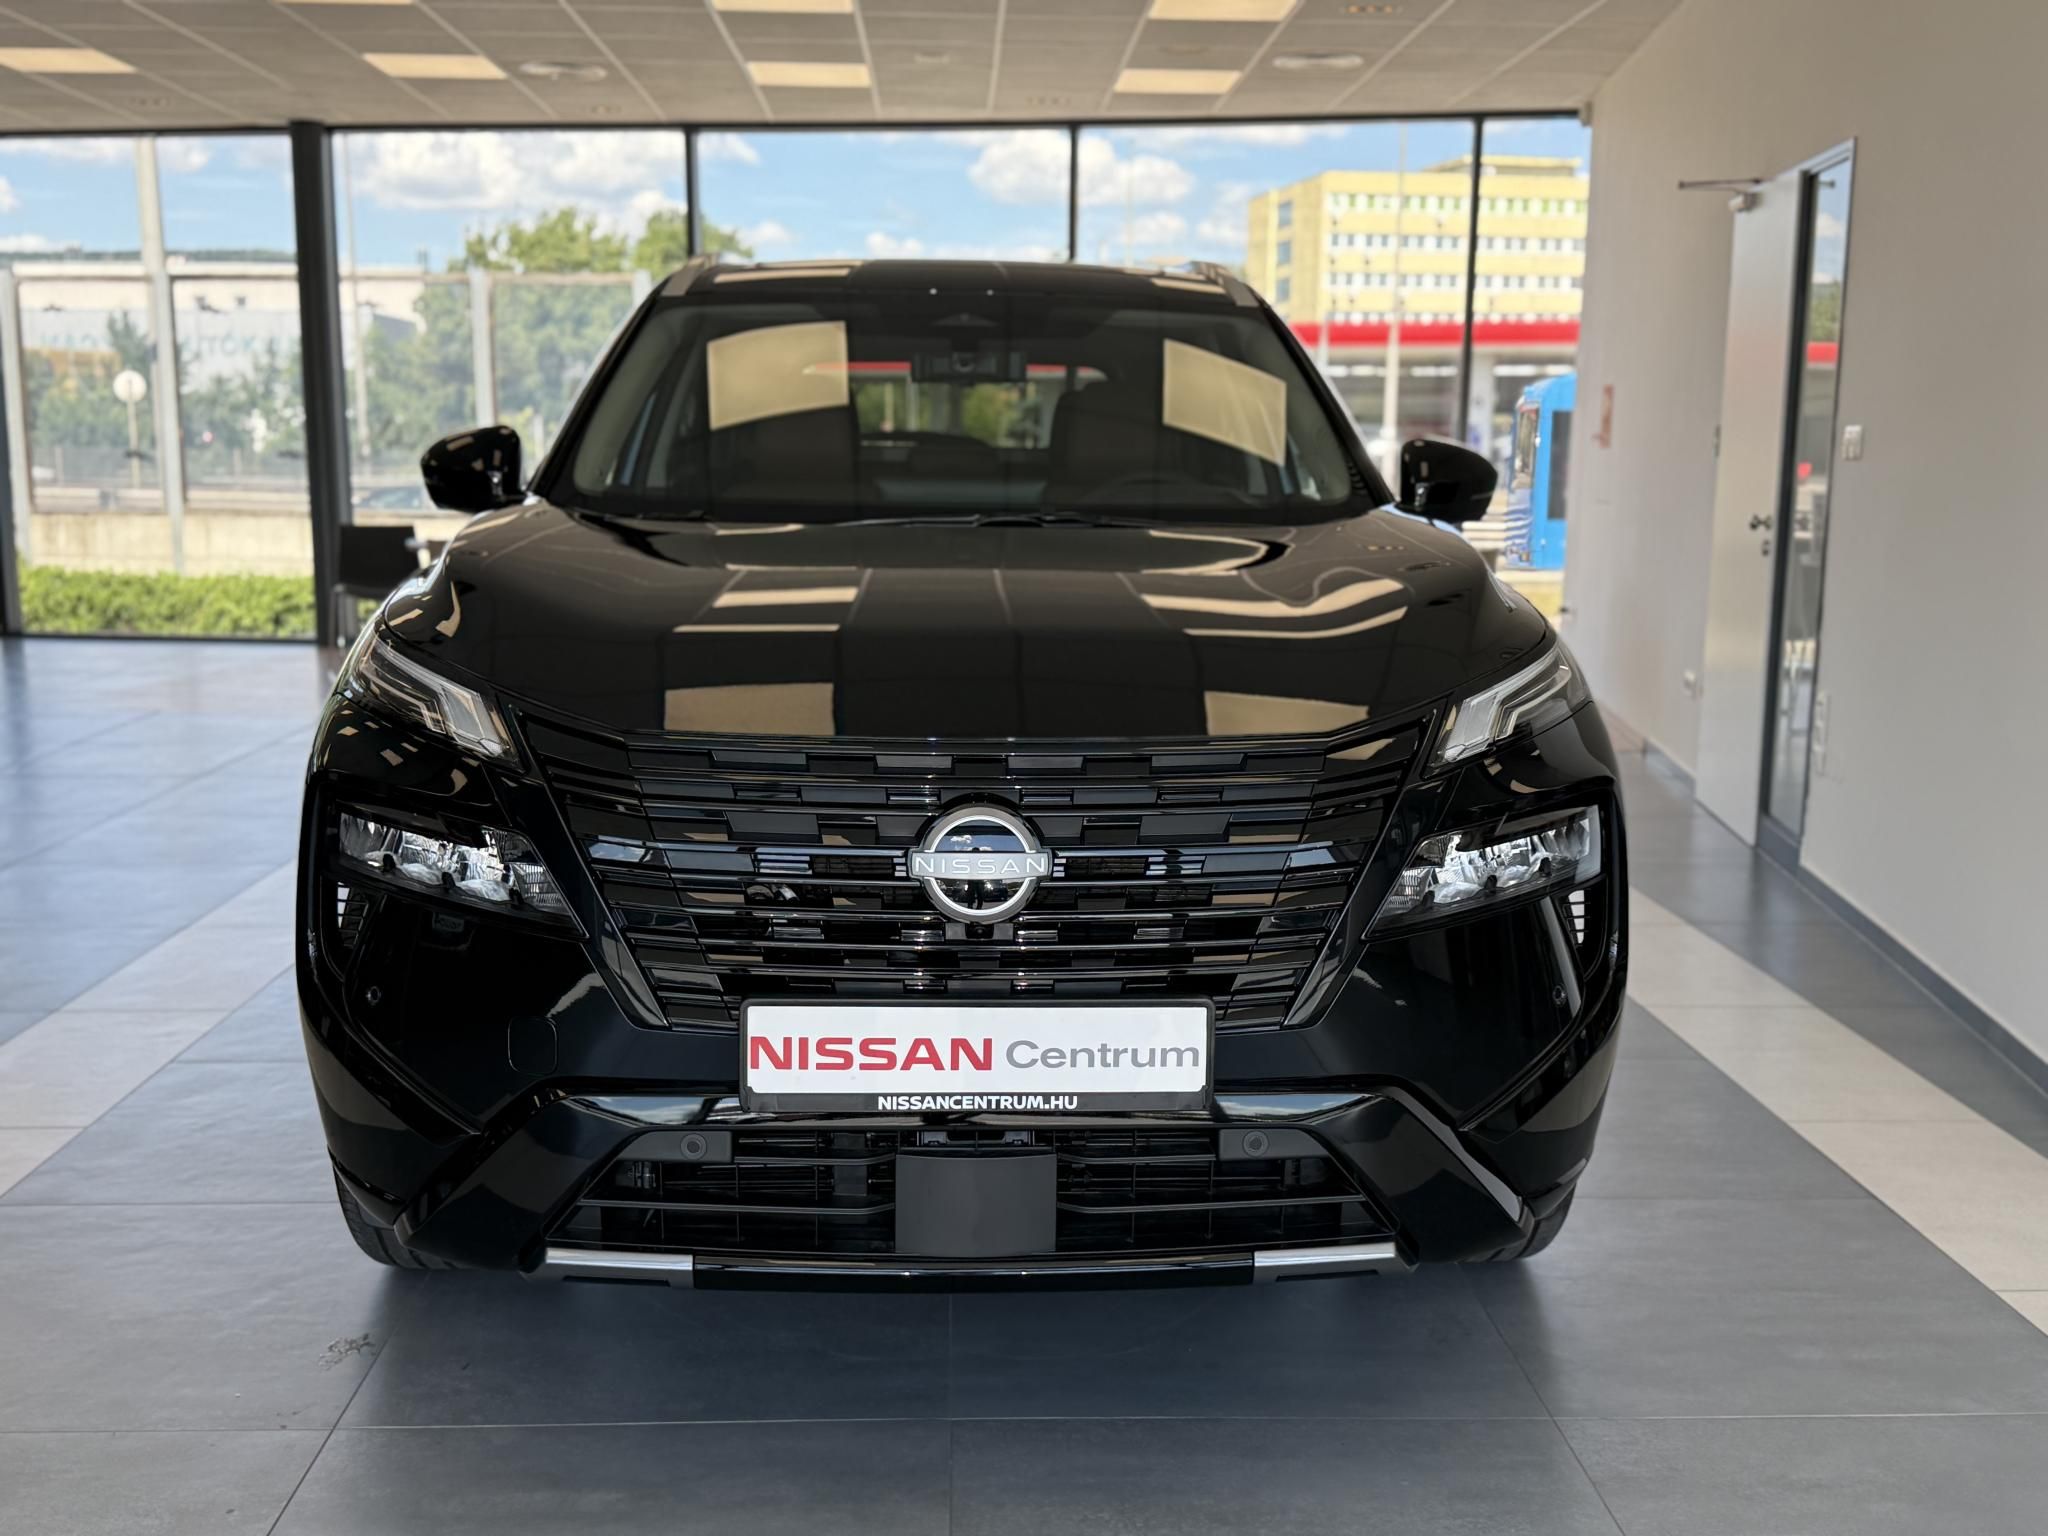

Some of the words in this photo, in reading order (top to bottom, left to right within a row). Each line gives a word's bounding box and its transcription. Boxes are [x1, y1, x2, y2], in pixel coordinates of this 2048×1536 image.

[914, 857, 1045, 874] NISSAN
[750, 1036, 993, 1071] NISSAN
[1005, 1039, 1200, 1069] Centrum
[877, 1095, 1078, 1111] NISSANCENTRUM.HU
